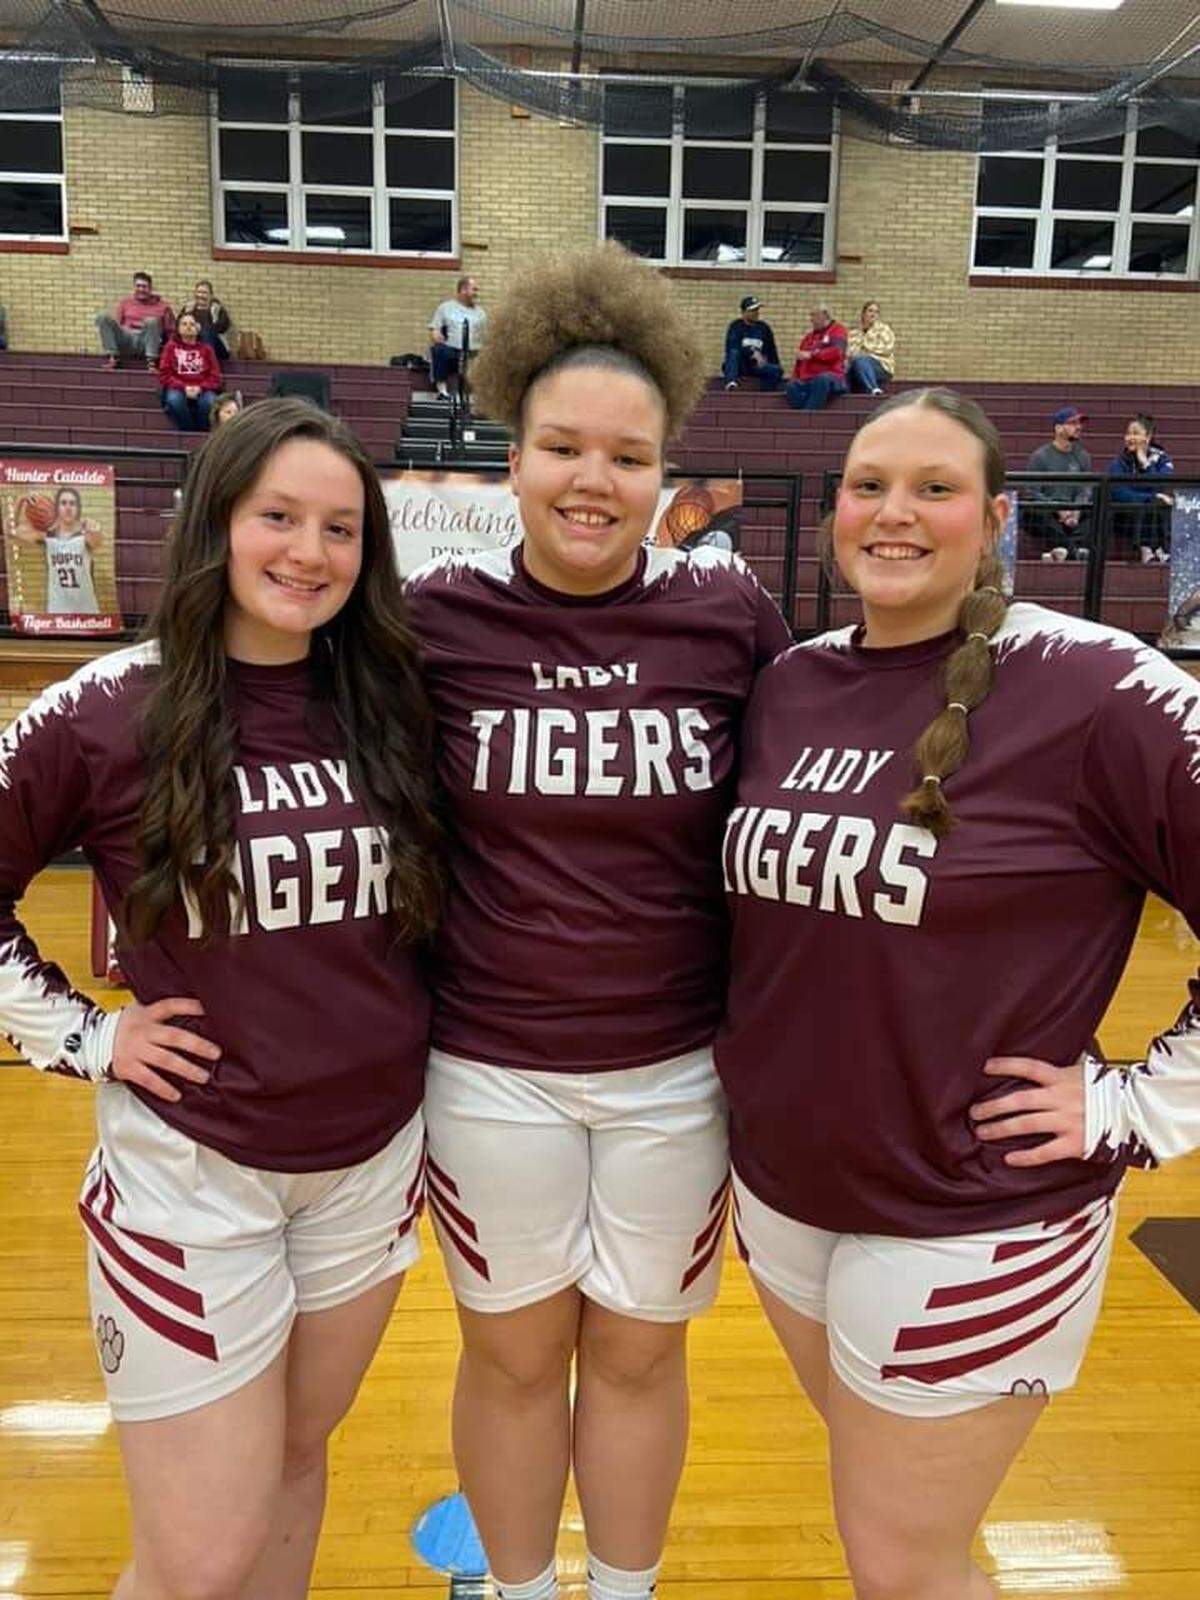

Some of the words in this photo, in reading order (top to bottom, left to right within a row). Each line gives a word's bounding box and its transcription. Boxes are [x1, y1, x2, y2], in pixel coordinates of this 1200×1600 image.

[389, 498, 517, 547] elebrating
[57, 568, 80, 588] 21
[21, 614, 52, 634] Tiger
[469, 707, 714, 797] TIGERS
[779, 746, 895, 794] LADY
[232, 759, 355, 814] LADY
[180, 825, 403, 939] IGER
